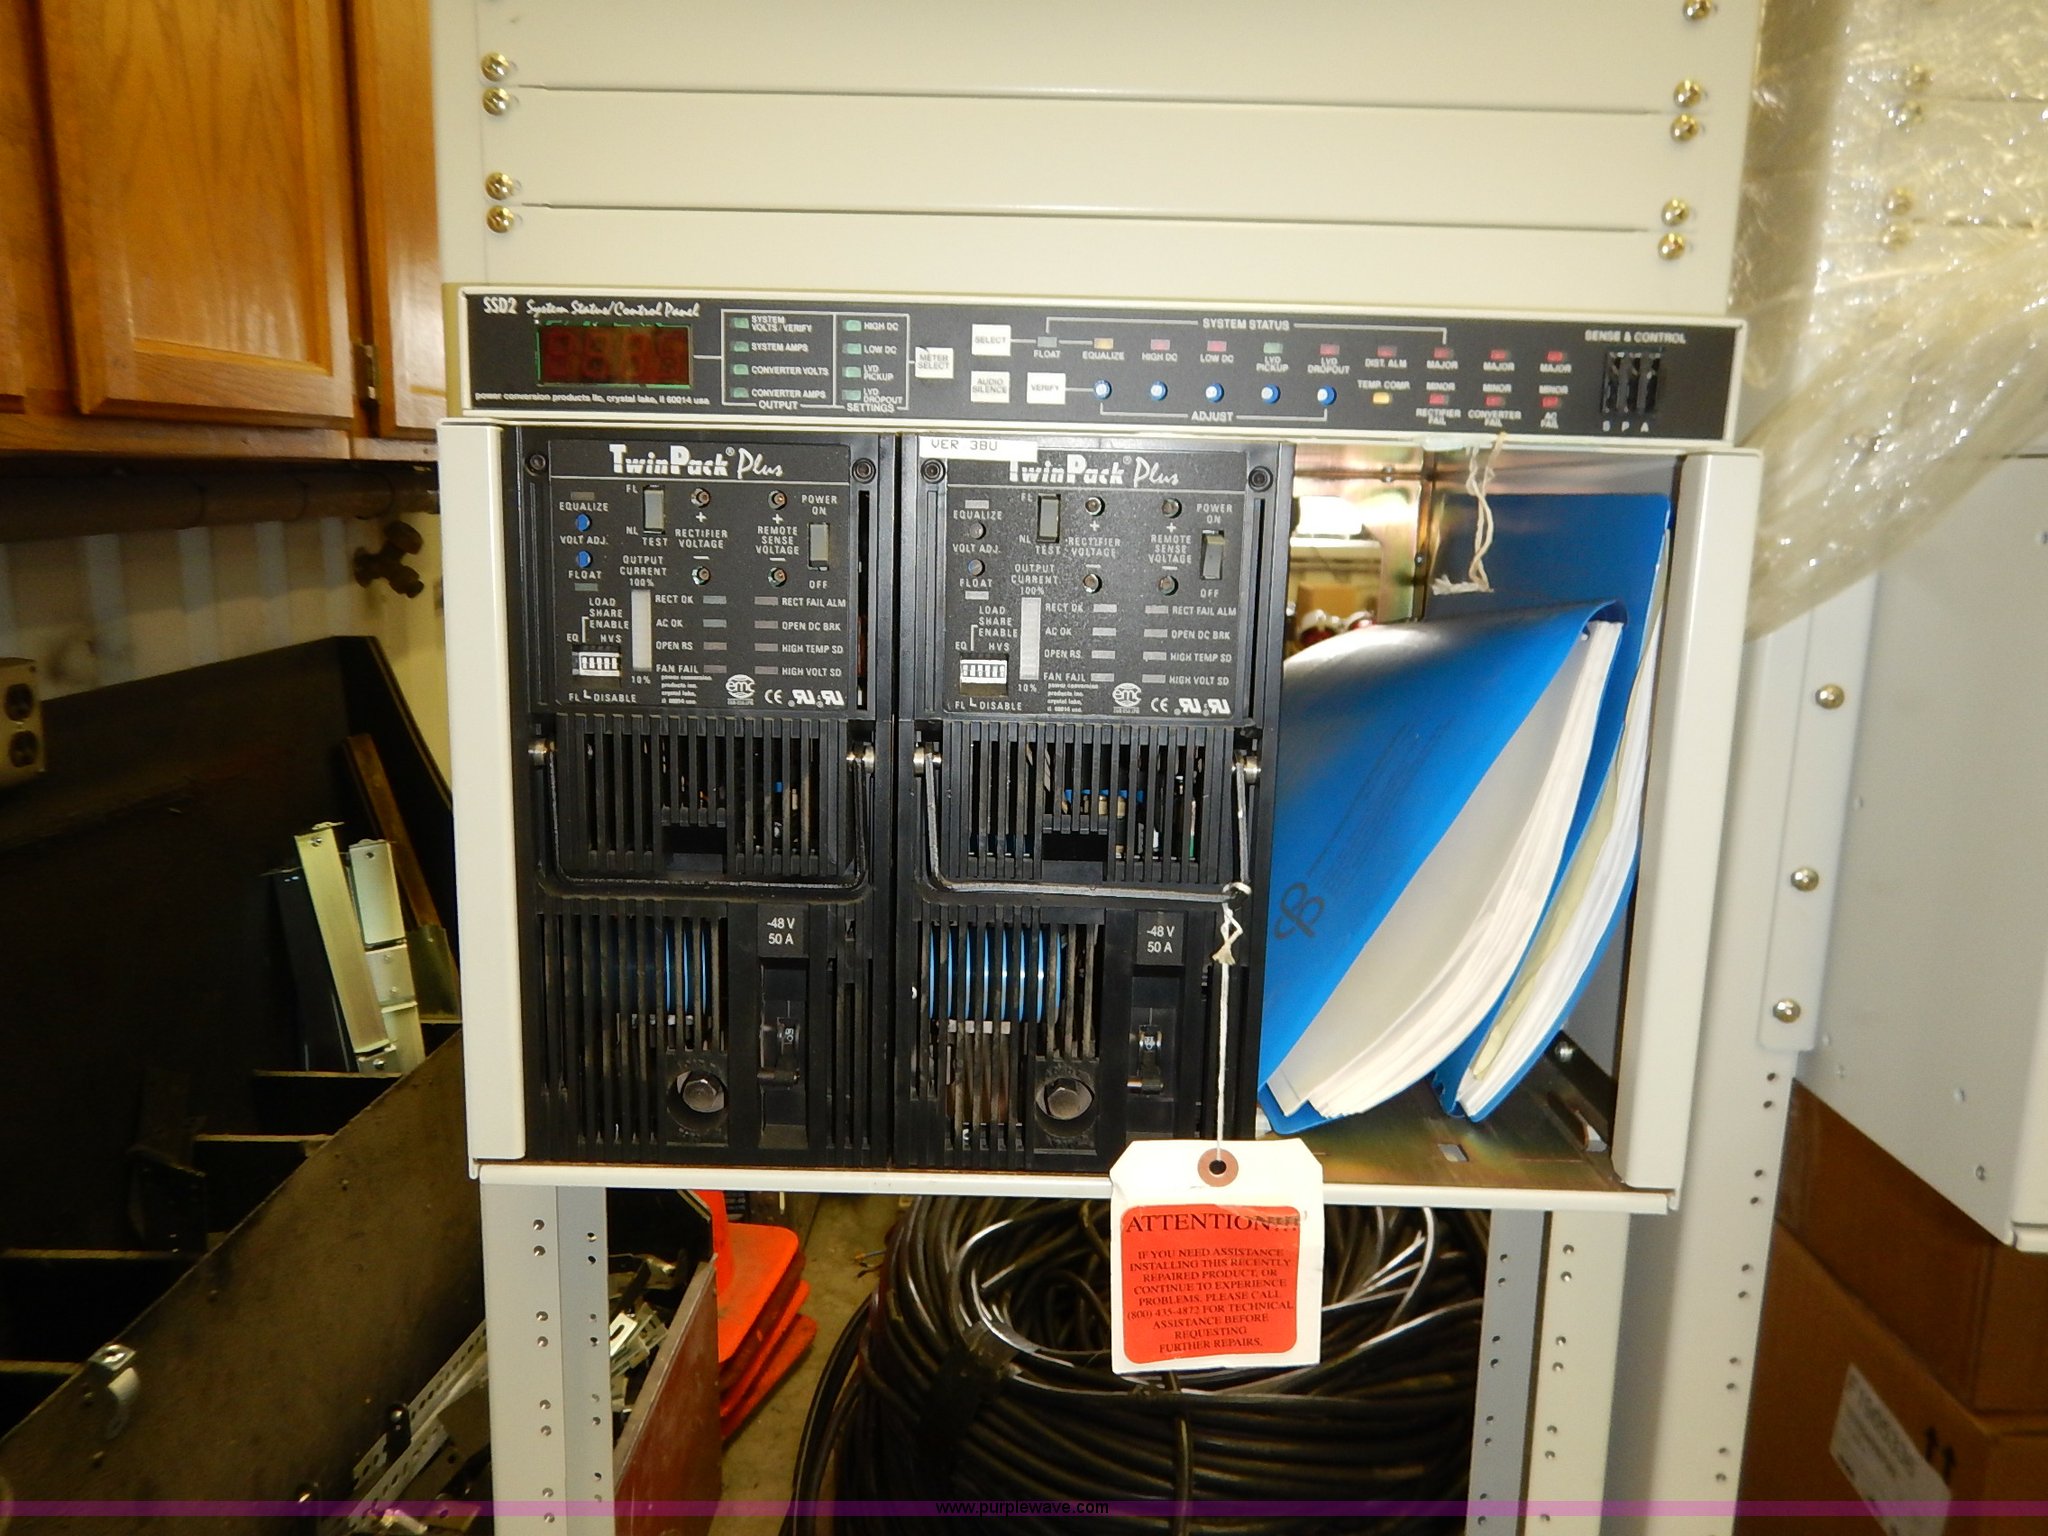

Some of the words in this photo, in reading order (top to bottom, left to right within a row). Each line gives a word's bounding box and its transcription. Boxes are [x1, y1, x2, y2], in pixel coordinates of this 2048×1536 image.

[483, 297, 518, 314] SSD2
[526, 300, 569, 318] System
[664, 302, 700, 317] Panel
[752, 324, 777, 332] VOLTS
[783, 324, 812, 333] VERIFY
[1203, 319, 1246, 329] SYSTEM
[1249, 320, 1290, 331] STATUS
[1634, 332, 1686, 344] CONTROL
[751, 343, 784, 351] SYSTEM
[785, 344, 809, 352] AMPS
[1034, 350, 1061, 359] FLOAT
[1083, 351, 1125, 360] EQUALIZE
[1307, 365, 1350, 374] DROPOUT
[1427, 361, 1459, 370] MAJOR
[1483, 362, 1515, 371] MAJOR
[1540, 363, 1572, 373] MAJOR
[752, 366, 801, 375] CONVERTER
[802, 367, 829, 376] VOLTS
[751, 389, 801, 398] CONVERTER
[803, 391, 826, 399] AMPS
[759, 401, 798, 410] OUTPUT
[847, 403, 895, 413] SETTINGS
[1192, 411, 1234, 421] ADJUST
[1416, 408, 1461, 418] RECTIFIER
[1468, 410, 1522, 419] CONVERTER
[931, 439, 959, 449] VER
[737, 447, 783, 479] Plus
[1133, 456, 1179, 488] Plus
[802, 495, 838, 504] POWER
[559, 502, 609, 512] EQUALIZE
[812, 506, 826, 516] ON
[1197, 503, 1233, 513] POWER
[953, 510, 1003, 519] EQUALIZE
[1207, 515, 1221, 524] ON
[626, 526, 639, 535] NL
[675, 529, 728, 538] RECTIFIER
[757, 526, 798, 535] REMOTE
[560, 535, 584, 544] VOLT
[587, 536, 608, 545] ADJ.
[642, 537, 668, 546] TEST
[679, 539, 724, 549] VOLTAGE
[761, 536, 794, 545] SENSE
[1151, 535, 1192, 544] REMOTE
[755, 545, 799, 555] VOLTAGE
[1035, 546, 1060, 555] TEST
[1071, 548, 1116, 558] VOLTAGE
[1155, 544, 1186, 554] SENSE
[623, 555, 663, 565] OUTPUT
[1148, 554, 1192, 564] VOLTAGE
[619, 567, 667, 576] CURRENT
[1015, 564, 1054, 573] OUTPUT
[568, 570, 602, 579] FLOAT
[629, 578, 655, 587] 100%
[809, 580, 828, 589] OFF
[960, 579, 993, 588] FLOAT
[1011, 575, 1057, 585] CURRENT
[1020, 587, 1044, 595] 100%
[1200, 588, 1219, 598] OFF
[589, 598, 616, 606] LOAD
[655, 595, 677, 604] RECT
[681, 595, 694, 604] OK
[782, 597, 803, 606] RECT
[806, 598, 825, 607] FAIL
[826, 598, 846, 607] ALM
[589, 609, 623, 618] SHARE
[979, 606, 1005, 615] LOAD
[1172, 606, 1194, 615] RECT
[1197, 607, 1214, 616] FAIL
[1217, 607, 1236, 616] ALM
[589, 620, 629, 630] ENABLE
[656, 619, 669, 628] AC
[671, 619, 683, 628] OK
[782, 622, 806, 631] OPEN
[808, 622, 820, 631] DC
[823, 622, 841, 631] BRK
[979, 617, 1012, 626] SHARE
[566, 633, 579, 642] EQ
[979, 628, 1018, 638] ENABLE
[1171, 630, 1195, 639] OPEN
[1198, 630, 1210, 639] DC
[1212, 630, 1230, 640] BRK
[600, 634, 622, 643] HVS
[656, 641, 680, 650] OPEN
[682, 641, 693, 650] RS
[782, 644, 803, 653] HIGH
[806, 644, 829, 653] TEMP
[832, 645, 844, 654] SD
[989, 642, 1009, 651] HVS
[1045, 649, 1067, 658] OPEN
[1070, 650, 1081, 658] RS
[1170, 652, 1192, 661] HIGH
[1194, 653, 1218, 662] TEMP
[1220, 653, 1232, 663] SD
[656, 664, 675, 673] FAN
[679, 665, 699, 674] FAIL
[782, 667, 803, 676] HIGH
[806, 667, 827, 677] VOLT
[830, 668, 842, 677] SD
[631, 675, 651, 684] 10%
[1044, 673, 1061, 681] FAN
[1066, 673, 1086, 682] FAIL
[1169, 675, 1191, 684] HIGH
[1193, 676, 1215, 685] VOLT
[1217, 676, 1229, 685] SD
[594, 694, 637, 703] DISABLE
[980, 702, 1022, 711] DISABLE
[767, 917, 785, 930] -48
[786, 917, 795, 930] V
[1147, 926, 1164, 937] -48
[1166, 926, 1175, 937] V
[768, 933, 783, 945] 50
[785, 933, 794, 945] A
[1147, 941, 1162, 953] 50
[1163, 942, 1173, 953] A
[1138, 1251, 1147, 1260] IF
[1148, 1250, 1175, 1259] YOU
[1178, 1249, 1210, 1258] NEED
[1213, 1248, 1284, 1257] ASSISTANCE
[1130, 1260, 1199, 1272] INSTALLING
[1202, 1259, 1228, 1268] THIS
[1231, 1258, 1291, 1267] RECENTLY
[1143, 1272, 1199, 1282] REPAIRED
[1261, 1268, 1277, 1277] OR
[1133, 1282, 1194, 1295] CONTINUE
[1198, 1282, 1212, 1291] TO
[1215, 1278, 1287, 1290] EXPERIENCE
[1206, 1292, 1247, 1302] PLEASE
[1251, 1290, 1281, 1300] CALL
[1127, 1309, 1153, 1321] (800)
[1155, 1306, 1200, 1317] 435-4872
[1203, 1304, 1225, 1314] FOR
[1228, 1301, 1294, 1312] TECHNICAL
[1153, 1316, 1222, 1330] ASSISTANCE
[1224, 1314, 1269, 1324] BEFORE
[1175, 1326, 1247, 1340] REQUESTING
[1159, 1340, 1210, 1353] FURTHER
